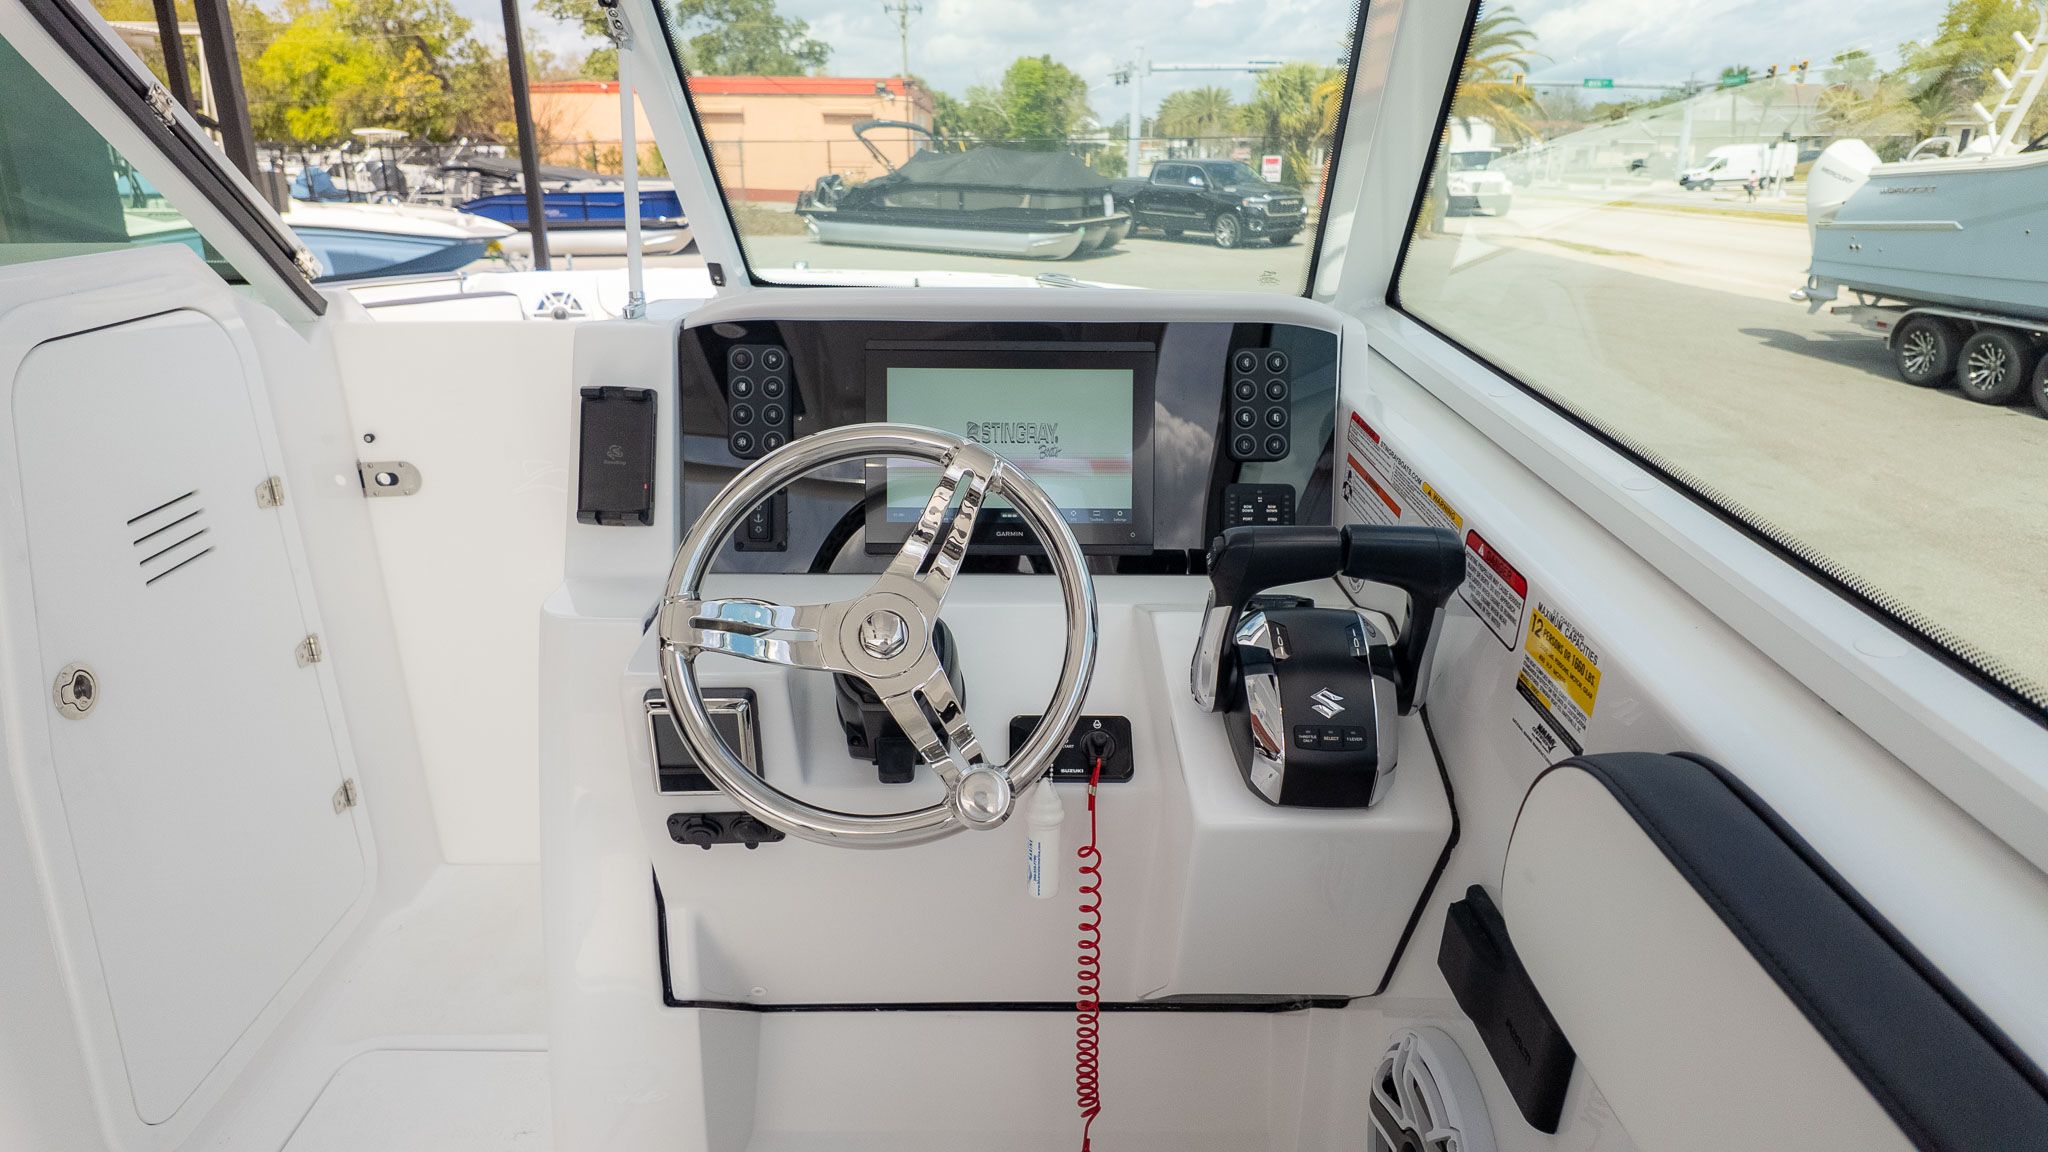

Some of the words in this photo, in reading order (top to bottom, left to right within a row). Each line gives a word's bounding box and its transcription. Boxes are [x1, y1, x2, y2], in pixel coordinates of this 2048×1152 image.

[981, 422, 1058, 444] STINGRAY
[1432, 496, 1456, 520] WARNING
[1486, 550, 1511, 580] DANGER
[1537, 601, 1563, 631] MAXIMUM
[1563, 626, 1598, 666] CAPACITIES
[1530, 612, 1544, 639] 12
[1542, 627, 1564, 655] PERSONS
[1563, 647, 1571, 662] OR
[1584, 668, 1596, 687] LBS.
